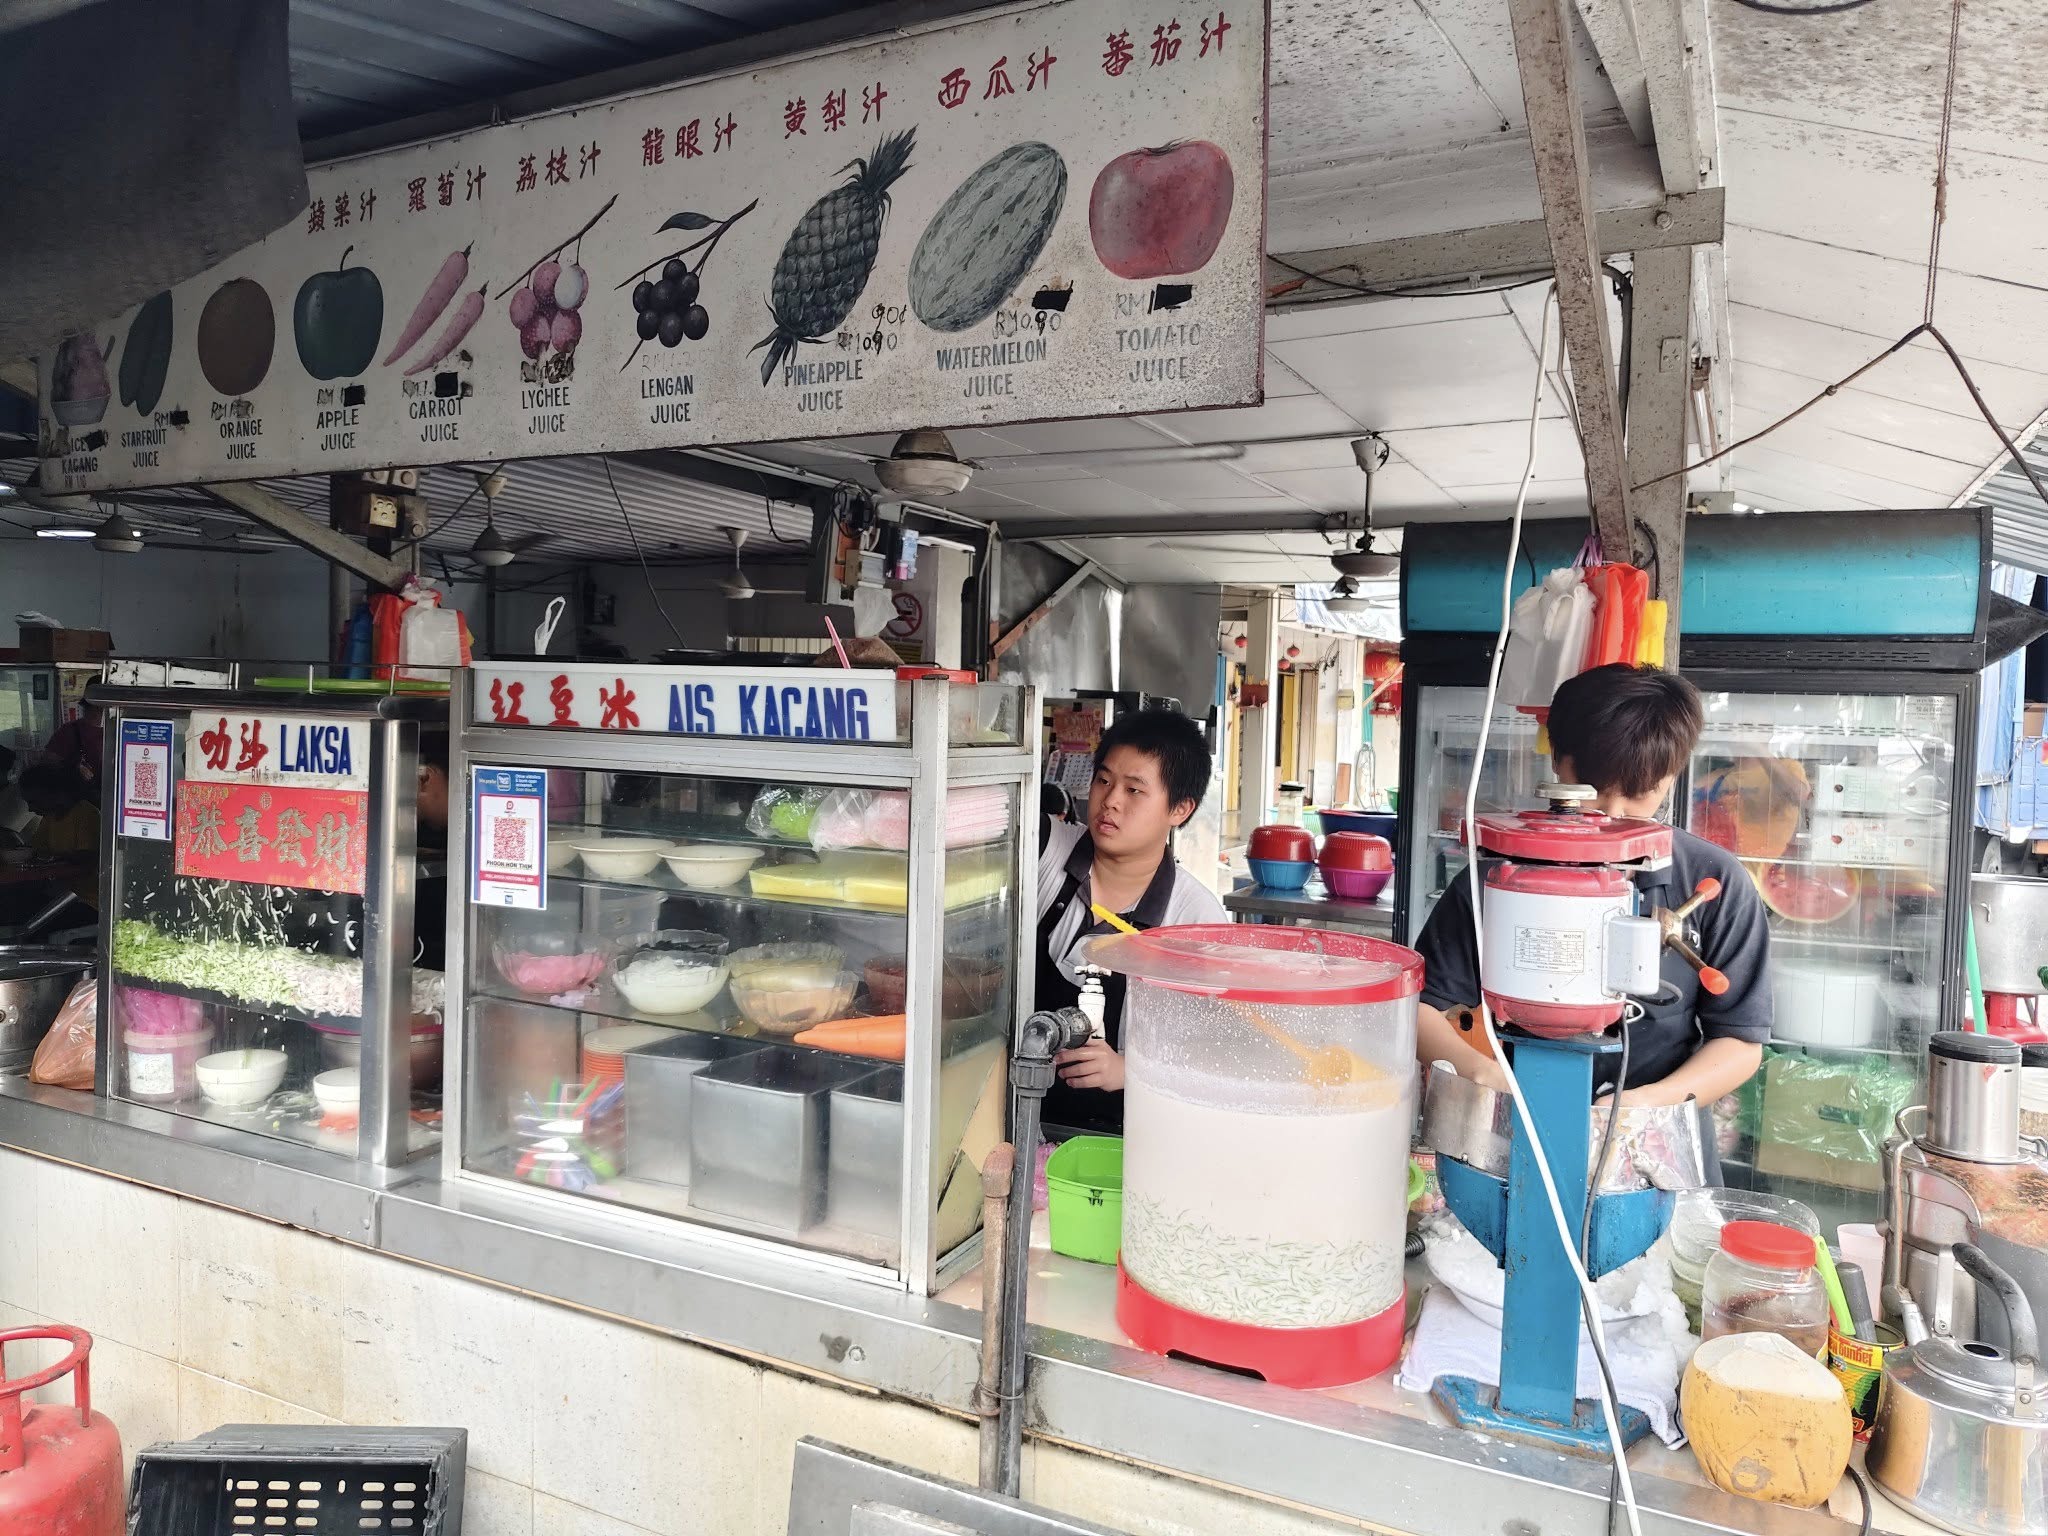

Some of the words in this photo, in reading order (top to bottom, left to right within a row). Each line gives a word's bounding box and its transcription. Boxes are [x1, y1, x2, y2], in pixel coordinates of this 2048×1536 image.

[1102, 12, 1232, 77] 蕃茄汁
[937, 46, 1058, 110] 西瓜汁
[641, 112, 739, 166] 龍眼汁
[515, 140, 603, 194] 荔枝汁
[1115, 323, 1202, 353] TOMATO
[936, 338, 1047, 372] WATERMELON
[784, 359, 863, 387] PINEAPPLE
[1128, 356, 1189, 384] JUICE
[522, 386, 571, 410] LYCHEE
[641, 375, 694, 399] LENGAN
[963, 374, 1014, 398] JUICE
[409, 397, 463, 420] CARROT
[651, 402, 692, 424] JUICE
[797, 390, 844, 412] JUICE
[219, 419, 263, 439] ORANGE
[316, 408, 360, 429] APPLE
[528, 413, 566, 435] JUICE
[121, 428, 168, 448] STARFRUIT
[320, 432, 357, 452] JUICE
[420, 423, 460, 443] JUICE
[132, 451, 160, 468] JUICE
[226, 442, 257, 460] JUICE
[668, 683, 716, 733] AIS
[738, 684, 871, 740] KACANG
[199, 717, 269, 772] 叻沙
[279, 724, 353, 775] LAKSA
[190, 801, 353, 872] 恭喜發財
